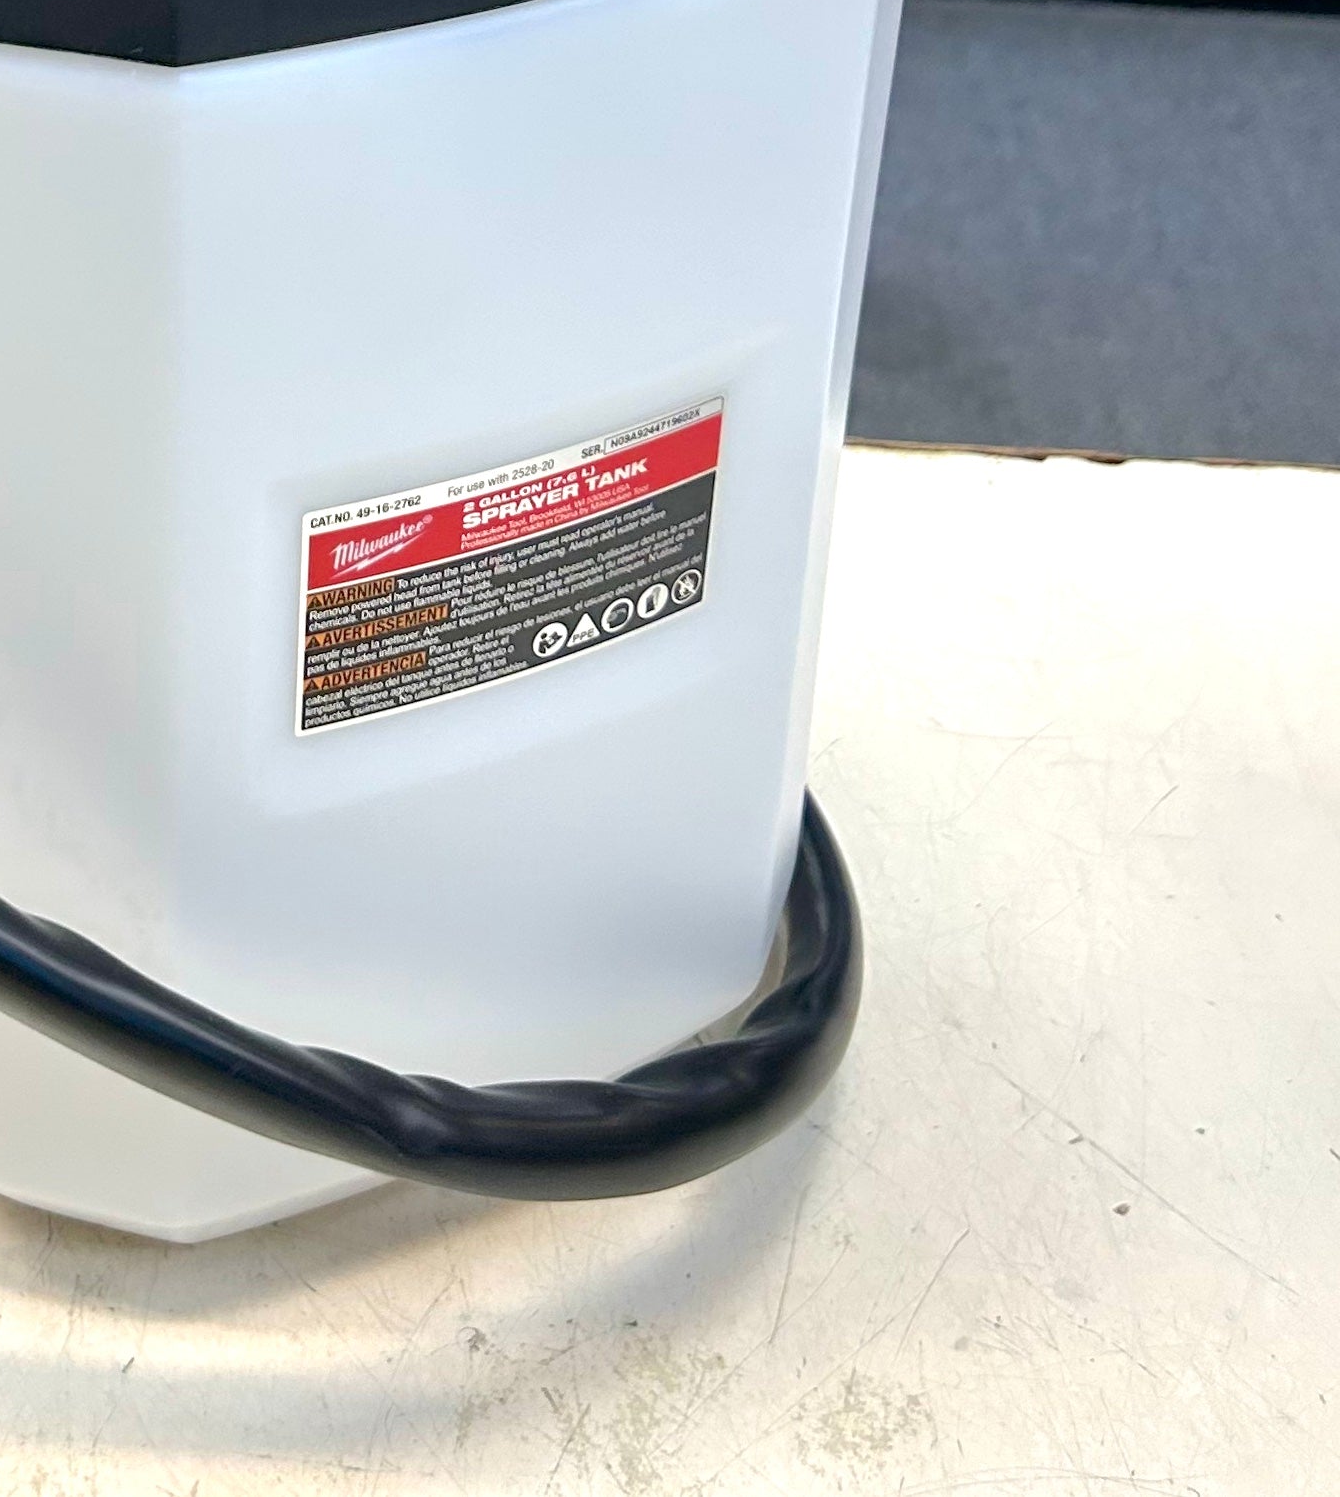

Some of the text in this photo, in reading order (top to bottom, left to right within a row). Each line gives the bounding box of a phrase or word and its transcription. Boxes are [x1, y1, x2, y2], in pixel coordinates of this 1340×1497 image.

[447, 458, 555, 496] For use with 2528-20
[461, 457, 648, 529] SPRAYER TANK
[356, 494, 421, 518] 49-16-2762
[461, 522, 506, 542] Milwaukee
[611, 481, 631, 495] USA
[462, 501, 475, 513] 2
[478, 481, 543, 508] GALLON
[460, 527, 519, 550] Professionally
[519, 519, 544, 533] made
[553, 508, 578, 523] China
[308, 604, 349, 620] Remove
[351, 594, 392, 611] powered
[393, 587, 417, 601] head
[418, 581, 440, 594] from
[442, 575, 462, 588] tank
[463, 567, 492, 583] before
[518, 556, 528, 567] or
[396, 578, 408, 589] To
[409, 569, 442, 586] reduce
[443, 565, 458, 577] the
[459, 560, 476, 573] risk
[477, 557, 487, 568] of
[321, 579, 393, 605] WARNING
[360, 609, 376, 620] Do
[376, 605, 392, 616] not
[394, 600, 411, 612] use
[412, 587, 460, 607] flammable
[450, 594, 472, 608] Pour
[323, 604, 446, 644] AVERTISSEMENT
[572, 627, 595, 642] PPE
[306, 664, 325, 675] pas
[326, 661, 339, 671] de
[341, 652, 377, 668] liquides
[341, 646, 354, 657] ou
[356, 643, 369, 653] de
[370, 640, 379, 650] la
[428, 641, 451, 655] Para
[321, 652, 424, 688] ADVERTENCIA
